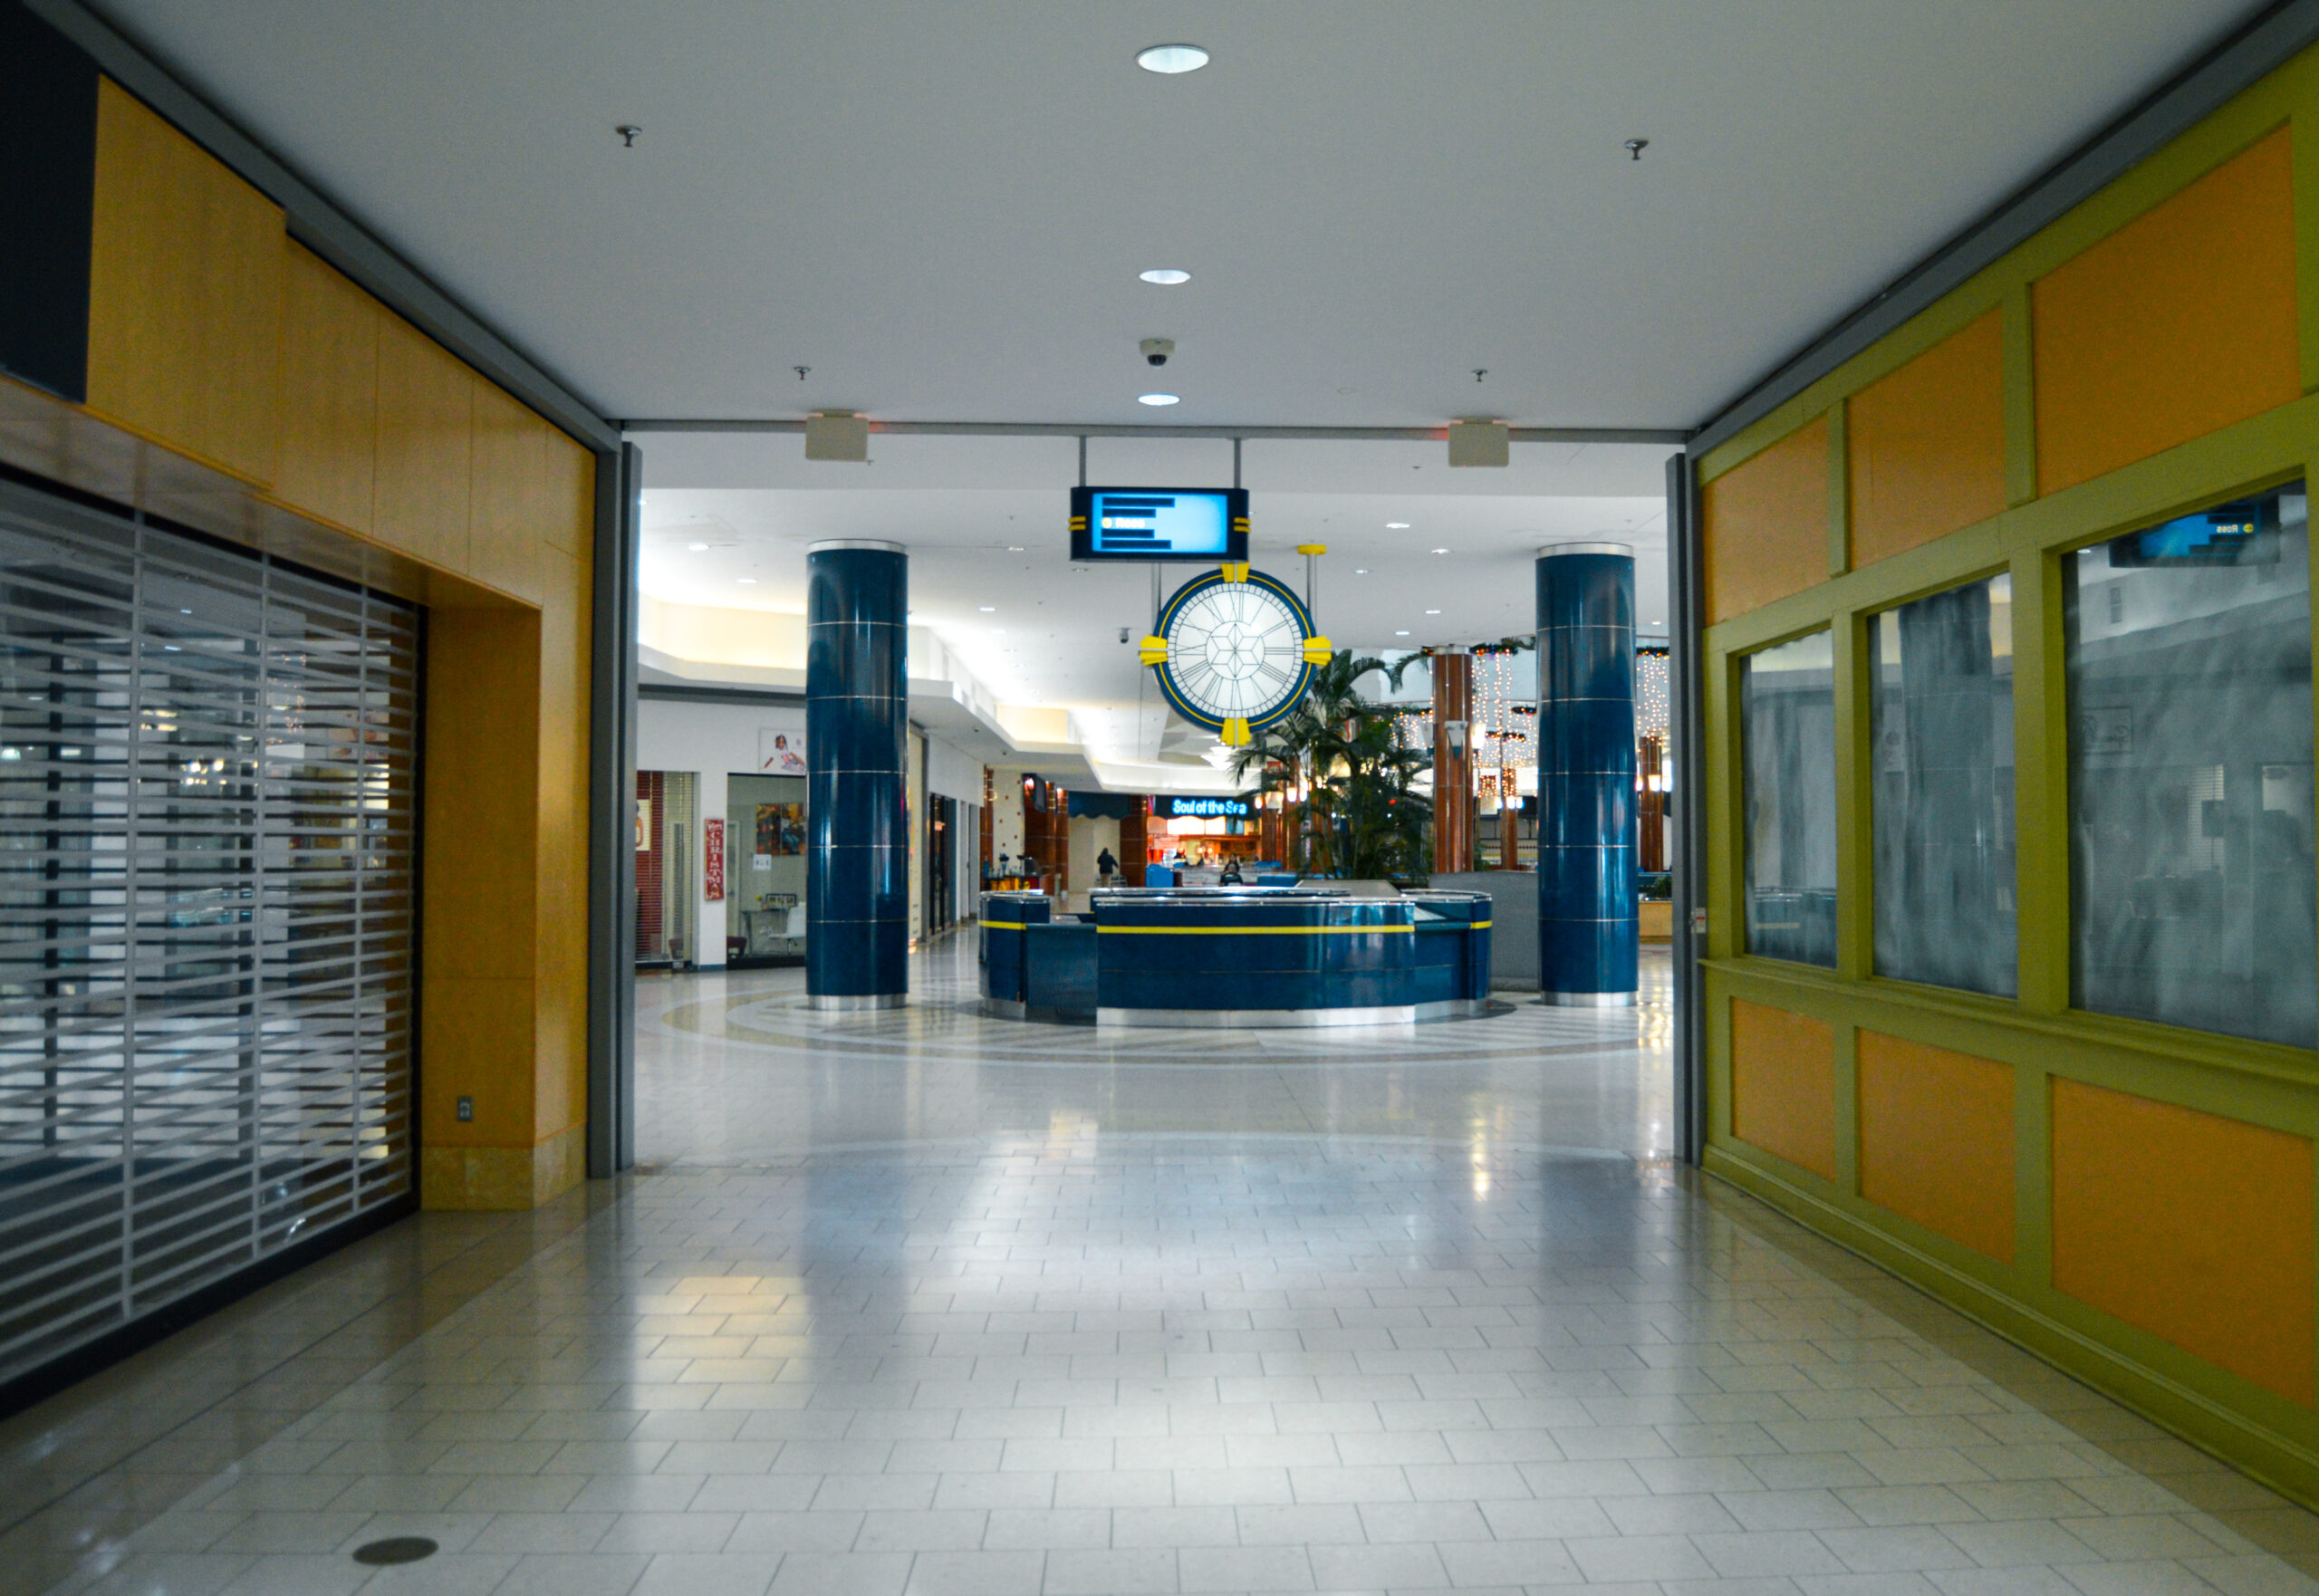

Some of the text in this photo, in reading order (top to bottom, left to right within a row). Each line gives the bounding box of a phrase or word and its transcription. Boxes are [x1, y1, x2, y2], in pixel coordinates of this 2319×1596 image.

[1115, 517, 1145, 528] Ross
[1172, 799, 1196, 814] Soul
[1196, 801, 1207, 814] of
[1208, 800, 1226, 814] the
